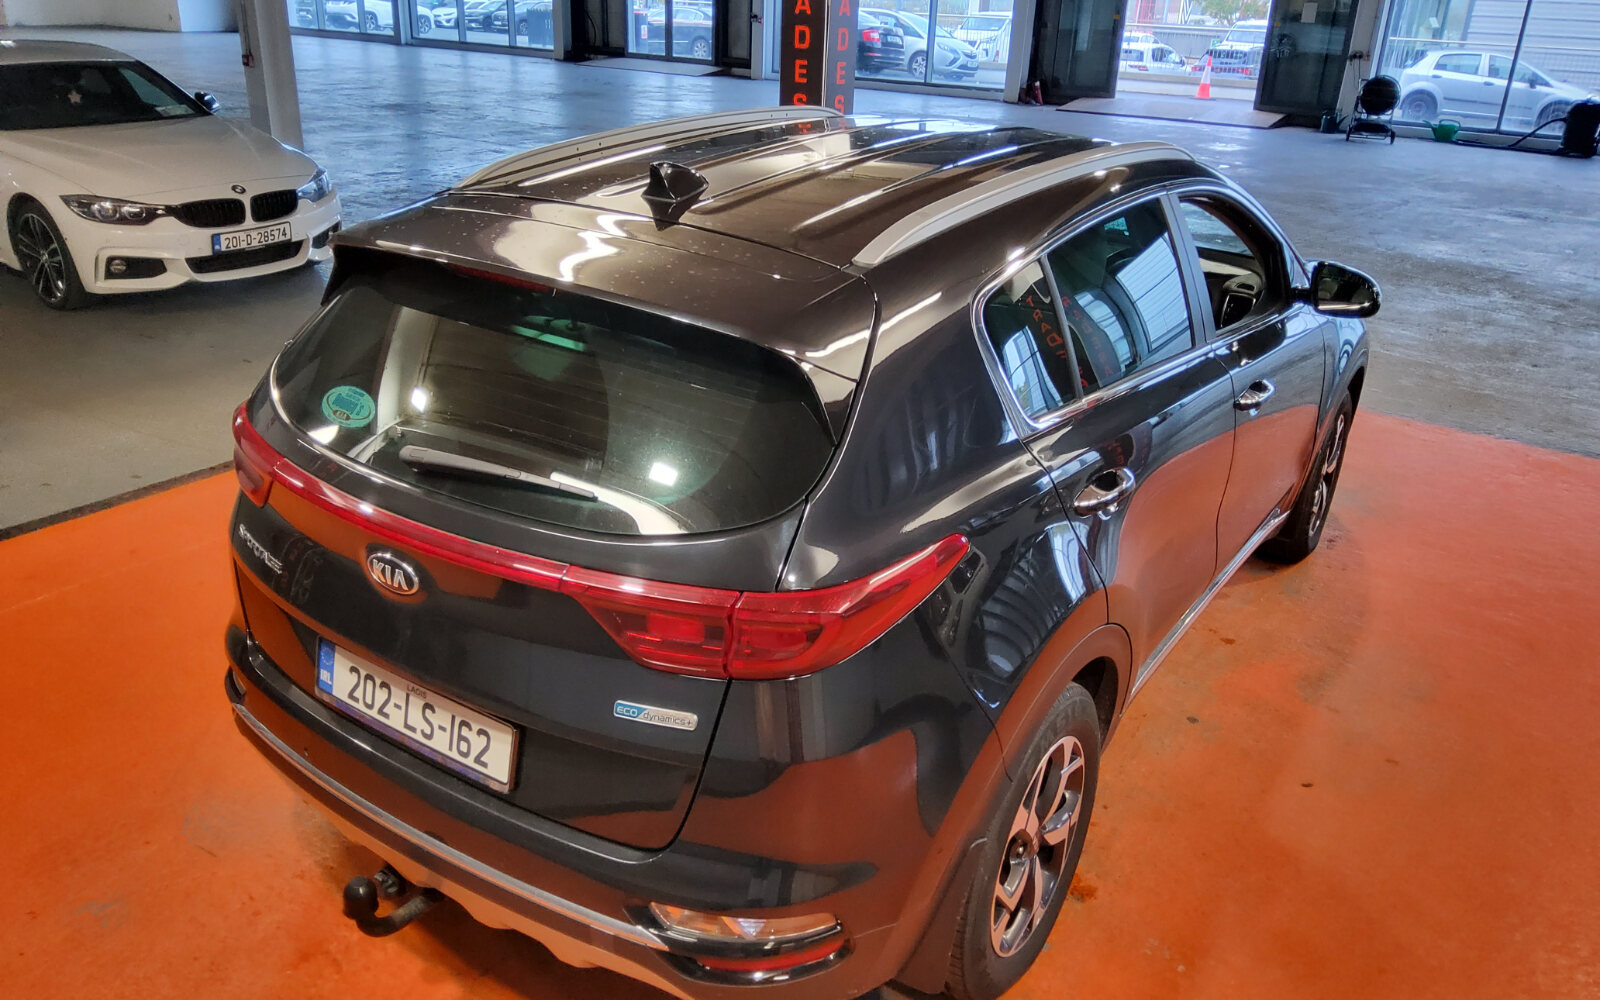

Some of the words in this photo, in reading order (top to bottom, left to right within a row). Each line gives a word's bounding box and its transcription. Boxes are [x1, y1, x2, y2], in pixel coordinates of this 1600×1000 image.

[224, 226, 287, 250] 201-D-28574
[372, 558, 409, 591] KIA
[347, 665, 492, 770] 202-LS-162
[616, 705, 638, 717] ECO
